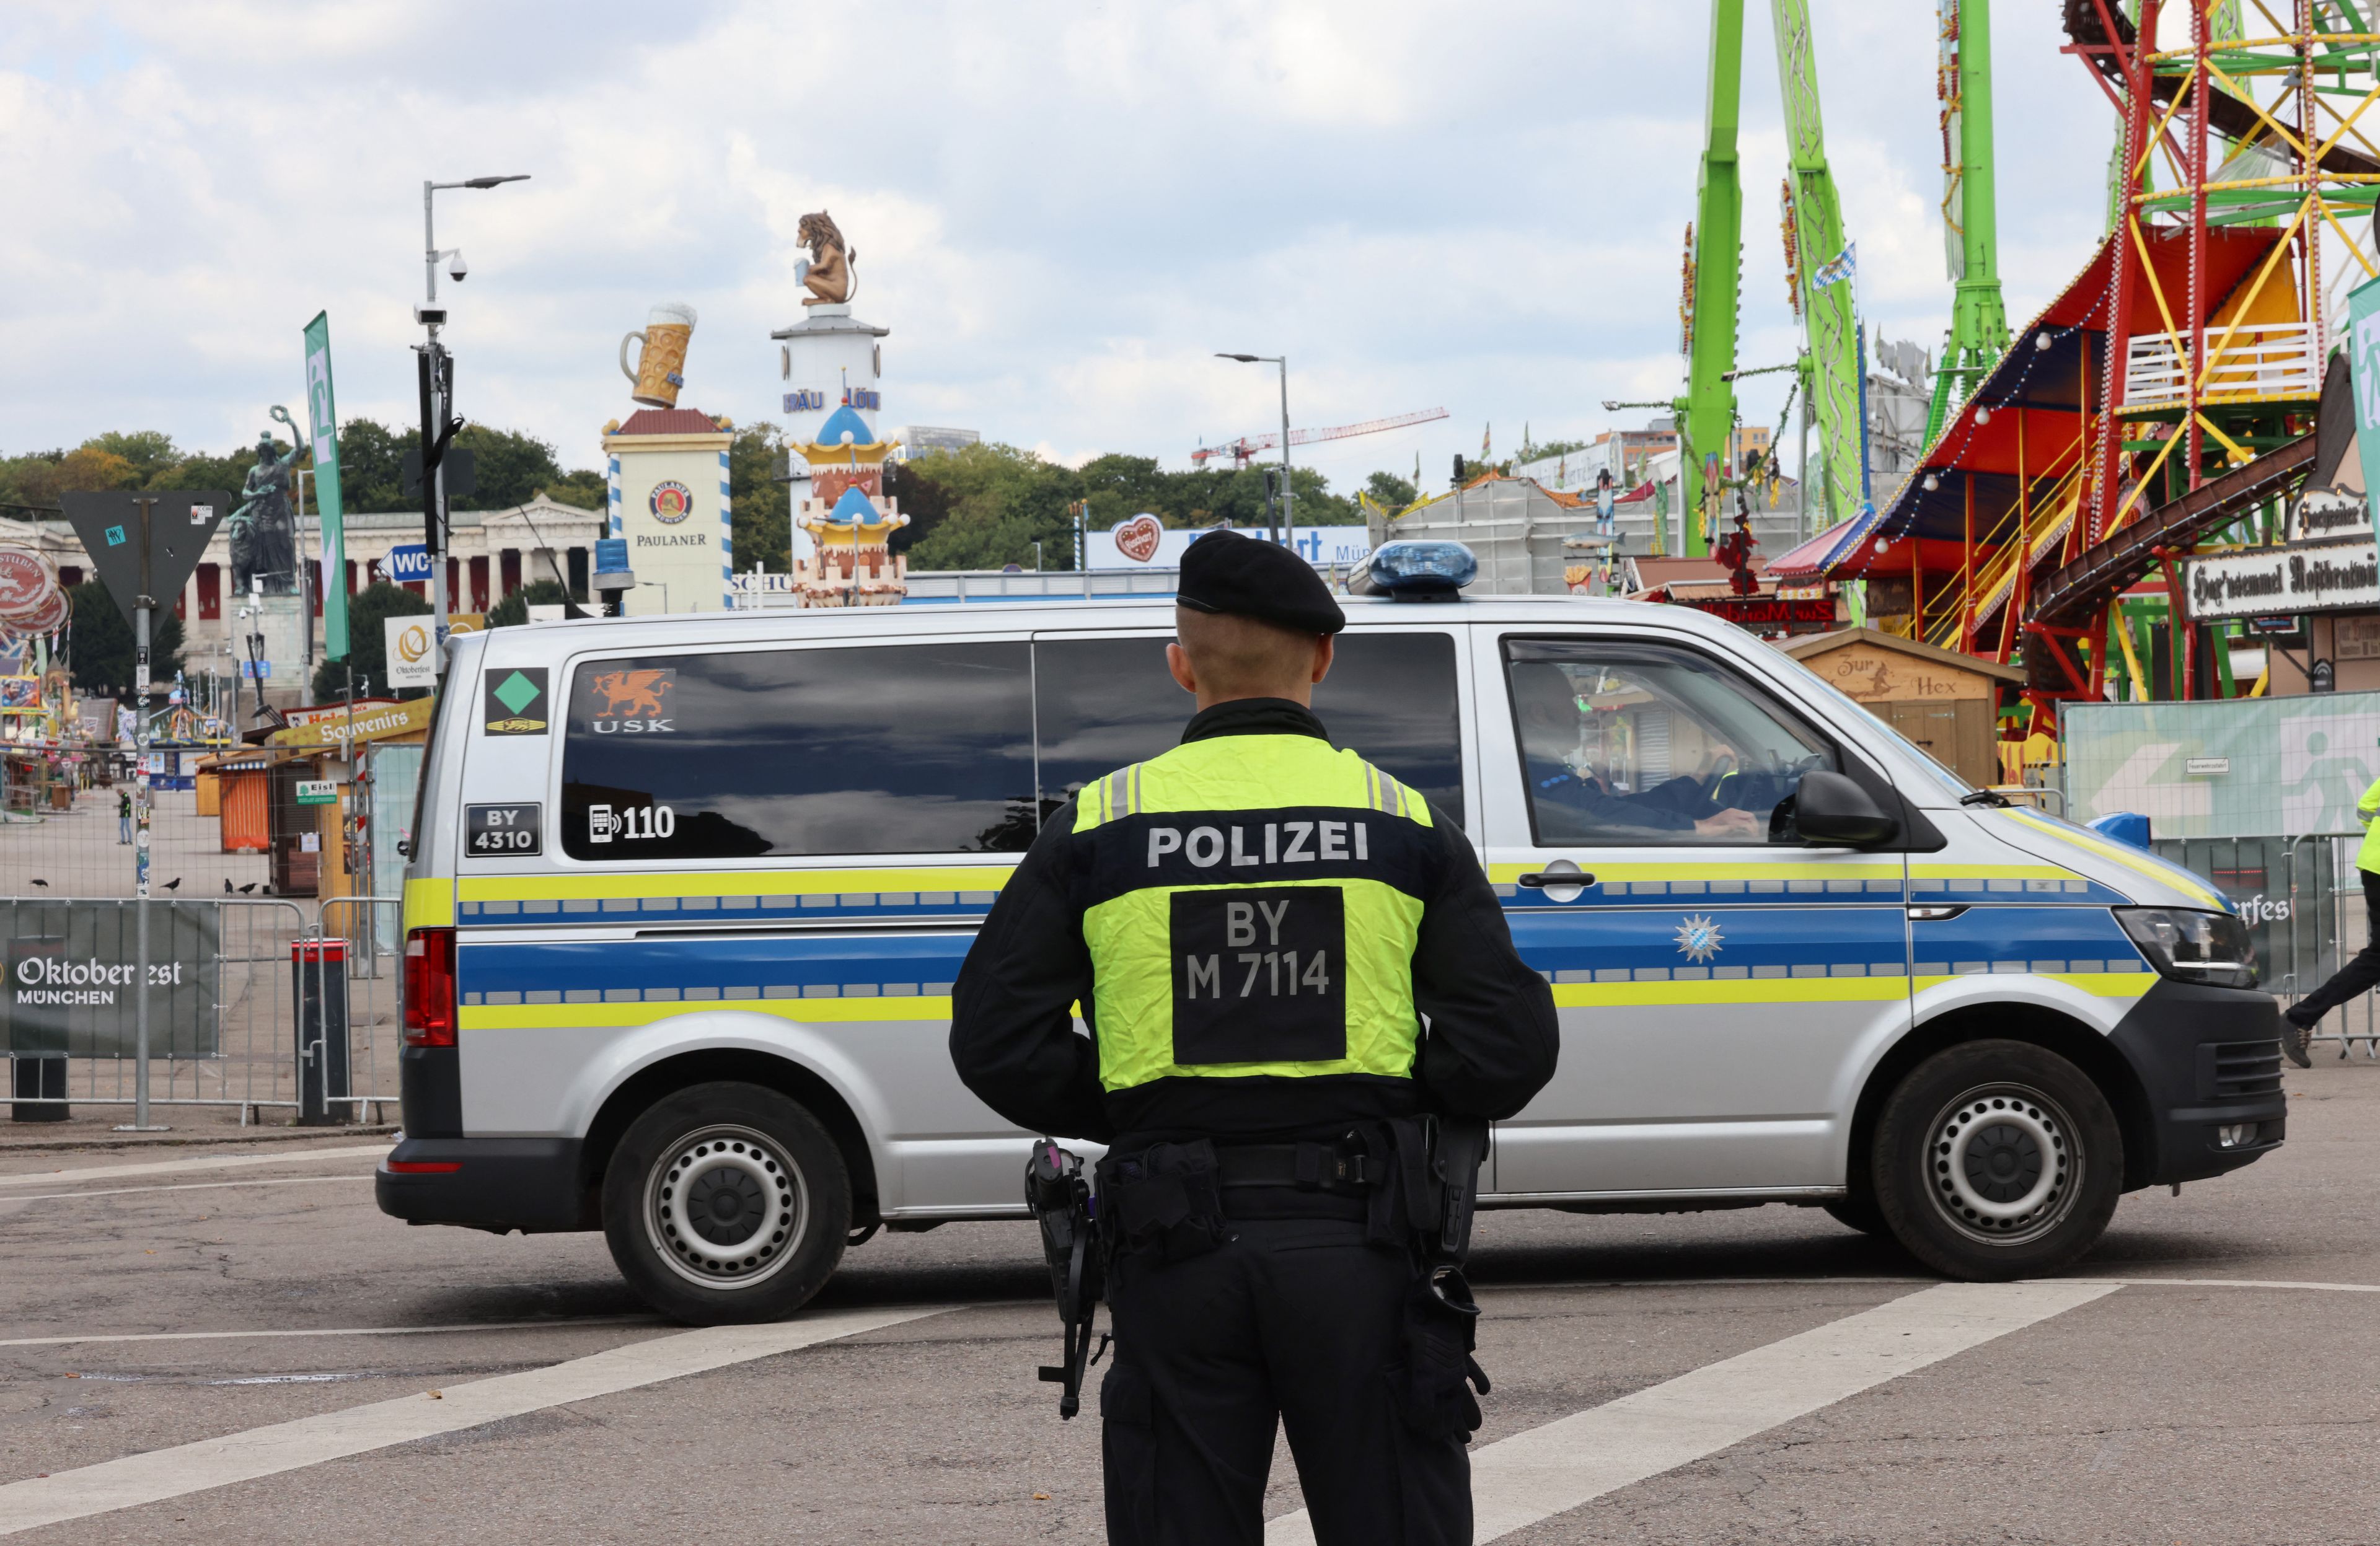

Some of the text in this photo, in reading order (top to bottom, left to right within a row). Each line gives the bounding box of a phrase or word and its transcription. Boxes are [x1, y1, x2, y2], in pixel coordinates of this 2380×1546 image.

[651, 482, 690, 499] PAULANER
[637, 534, 706, 546] PAULANER
[394, 551, 429, 573] WC
[1837, 654, 1874, 676] Zur
[1911, 677, 1956, 695] Hex
[320, 711, 408, 742] Souvenirs
[593, 719, 675, 733] USK
[311, 783, 332, 791] Eisl
[487, 809, 519, 827] BY
[623, 806, 675, 839] 110
[475, 830, 532, 850] 4310
[1147, 820, 1368, 867] POLIZEI
[1227, 900, 1289, 947] BY
[17, 957, 182, 985] Oktoberest
[1187, 950, 1329, 999] M 7114
[17, 990, 114, 1004] MÜNCHEN
